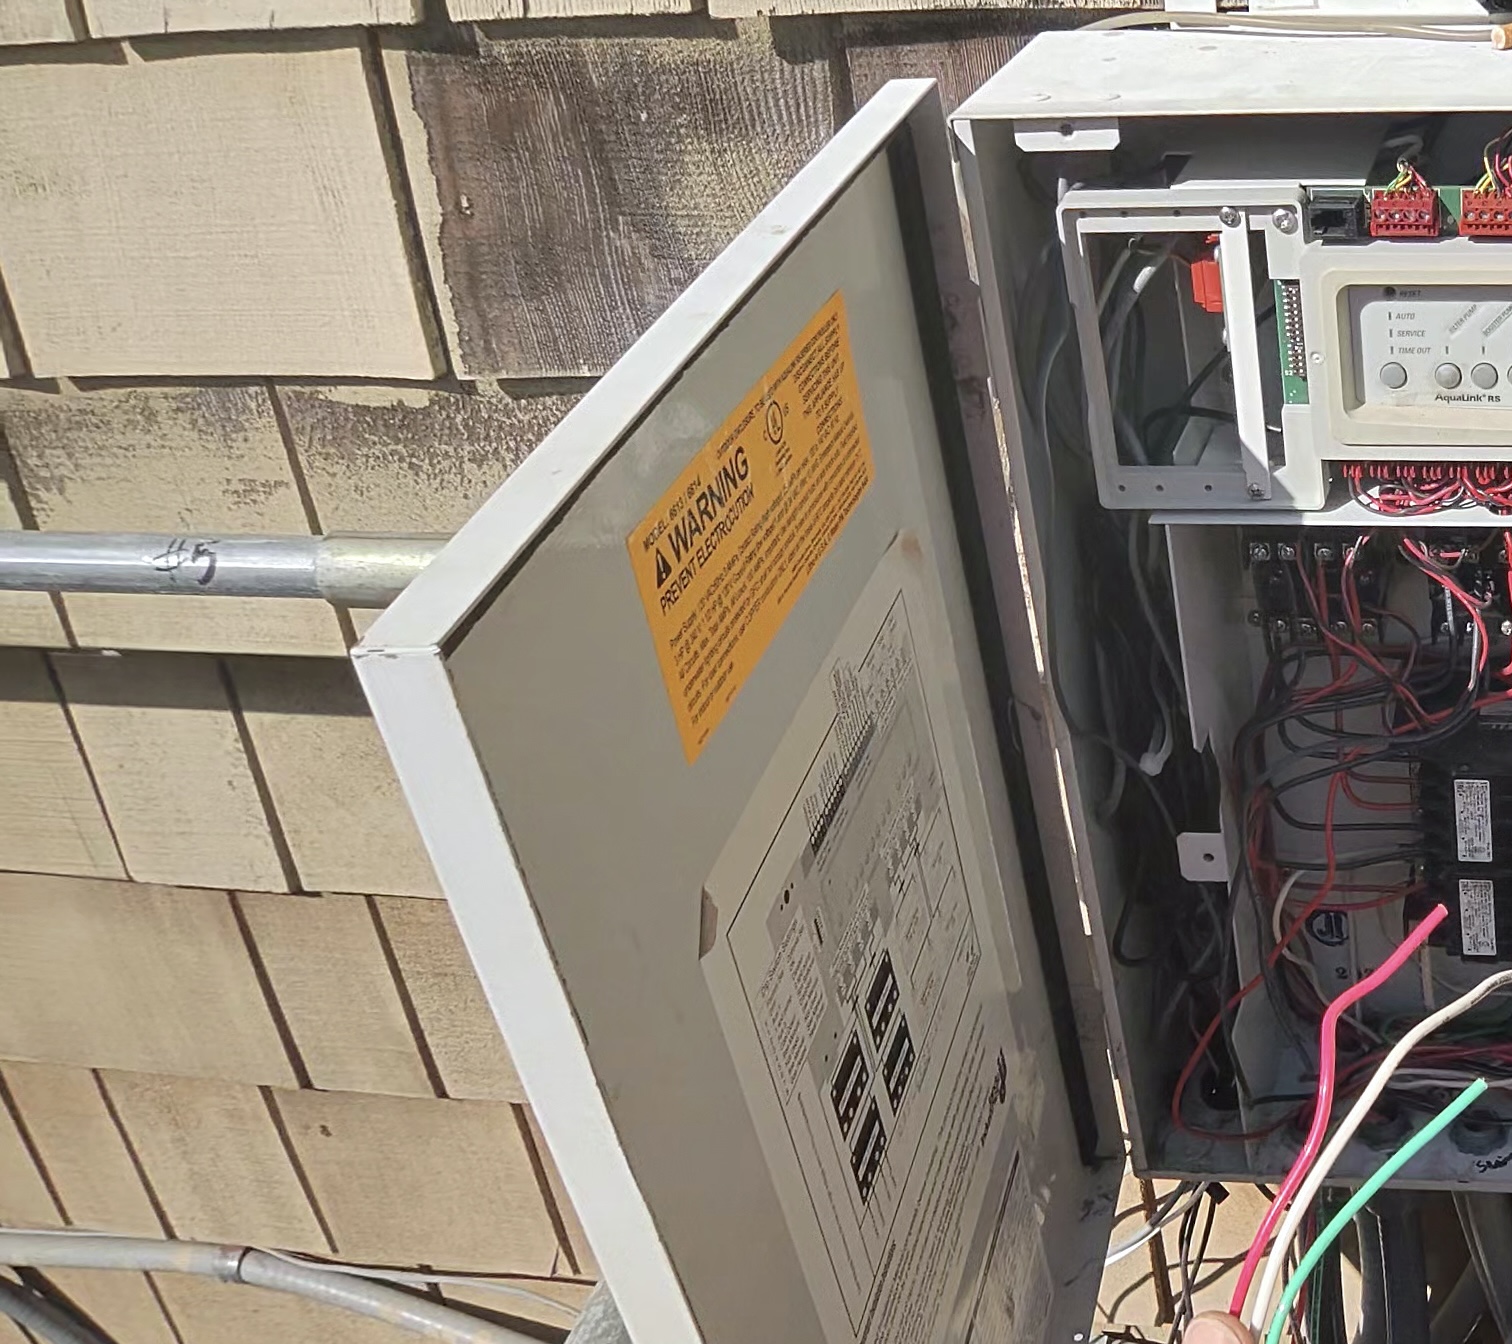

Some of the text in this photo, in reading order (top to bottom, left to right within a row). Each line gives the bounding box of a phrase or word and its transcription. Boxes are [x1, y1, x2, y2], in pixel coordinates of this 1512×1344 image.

[1395, 312, 1416, 320] AUTO
[1461, 303, 1479, 321] PUMP
[1396, 330, 1426, 338] SERVICE
[1398, 346, 1431, 355] TIME OUT
[1487, 395, 1501, 403] RS
[666, 441, 750, 567] WARNING
[659, 480, 755, 617] PREVENT ELECTROCUTION
